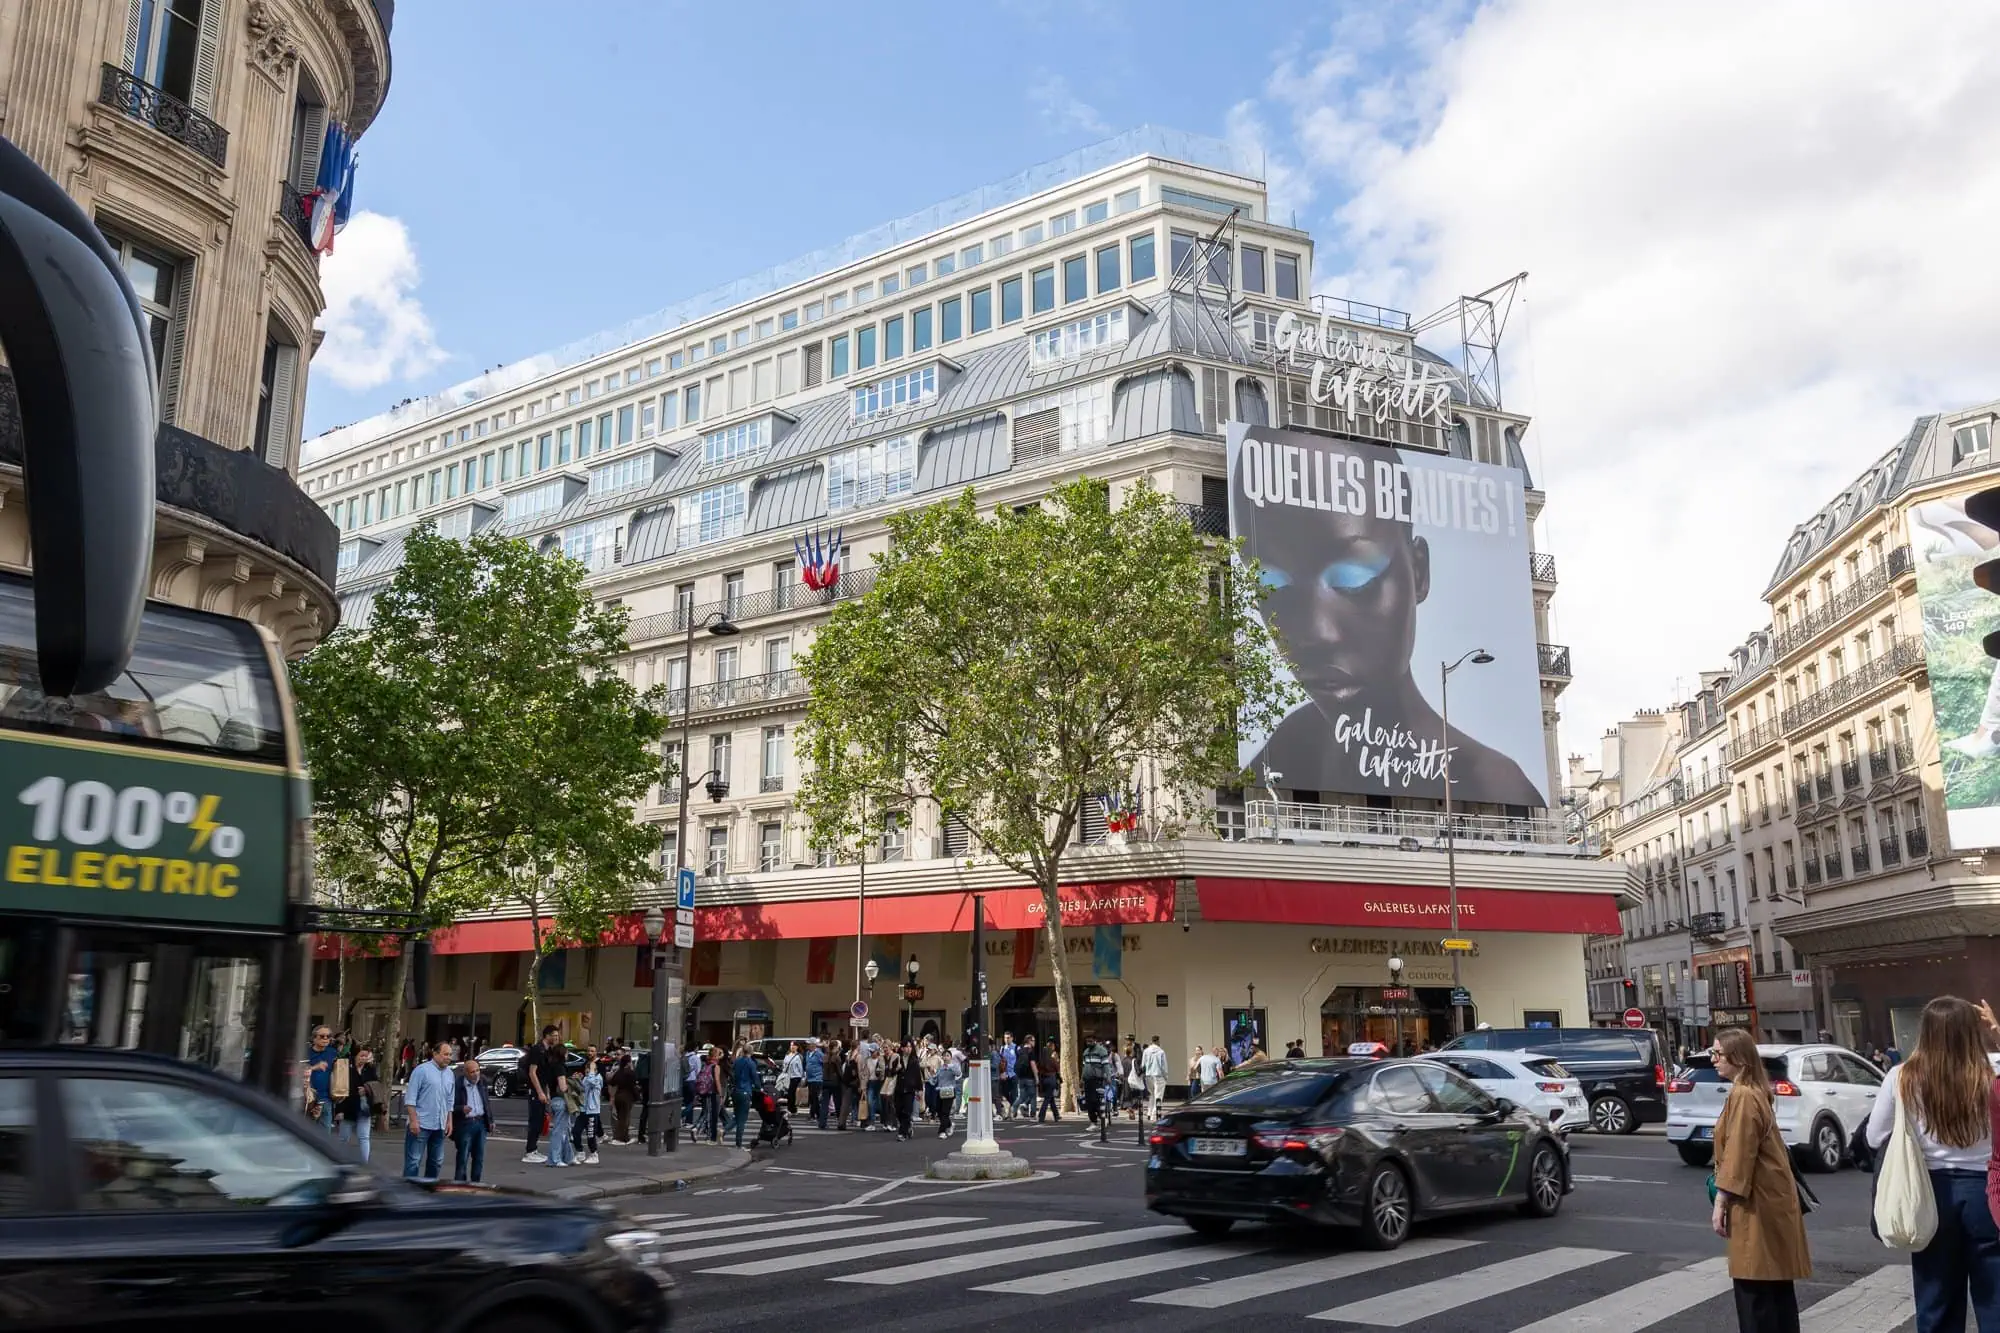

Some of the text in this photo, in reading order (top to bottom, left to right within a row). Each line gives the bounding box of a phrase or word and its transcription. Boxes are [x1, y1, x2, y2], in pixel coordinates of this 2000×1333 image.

[1274, 308, 1400, 372] Galeries
[1310, 358, 1461, 428] Lafayette
[1242, 438, 1517, 537] QUELLES BEAUTÉS !
[1335, 707, 1417, 753] Galeries
[1359, 740, 1460, 788] Lafayette
[17, 775, 245, 859] 100%
[6, 844, 240, 899] ELECTRIC
[682, 875, 691, 901] P
[1084, 896, 1145, 912] LAFAYETTE
[1363, 902, 1476, 915] GALERIES LAFAYTTE
[1310, 938, 1388, 955] GALERIES
